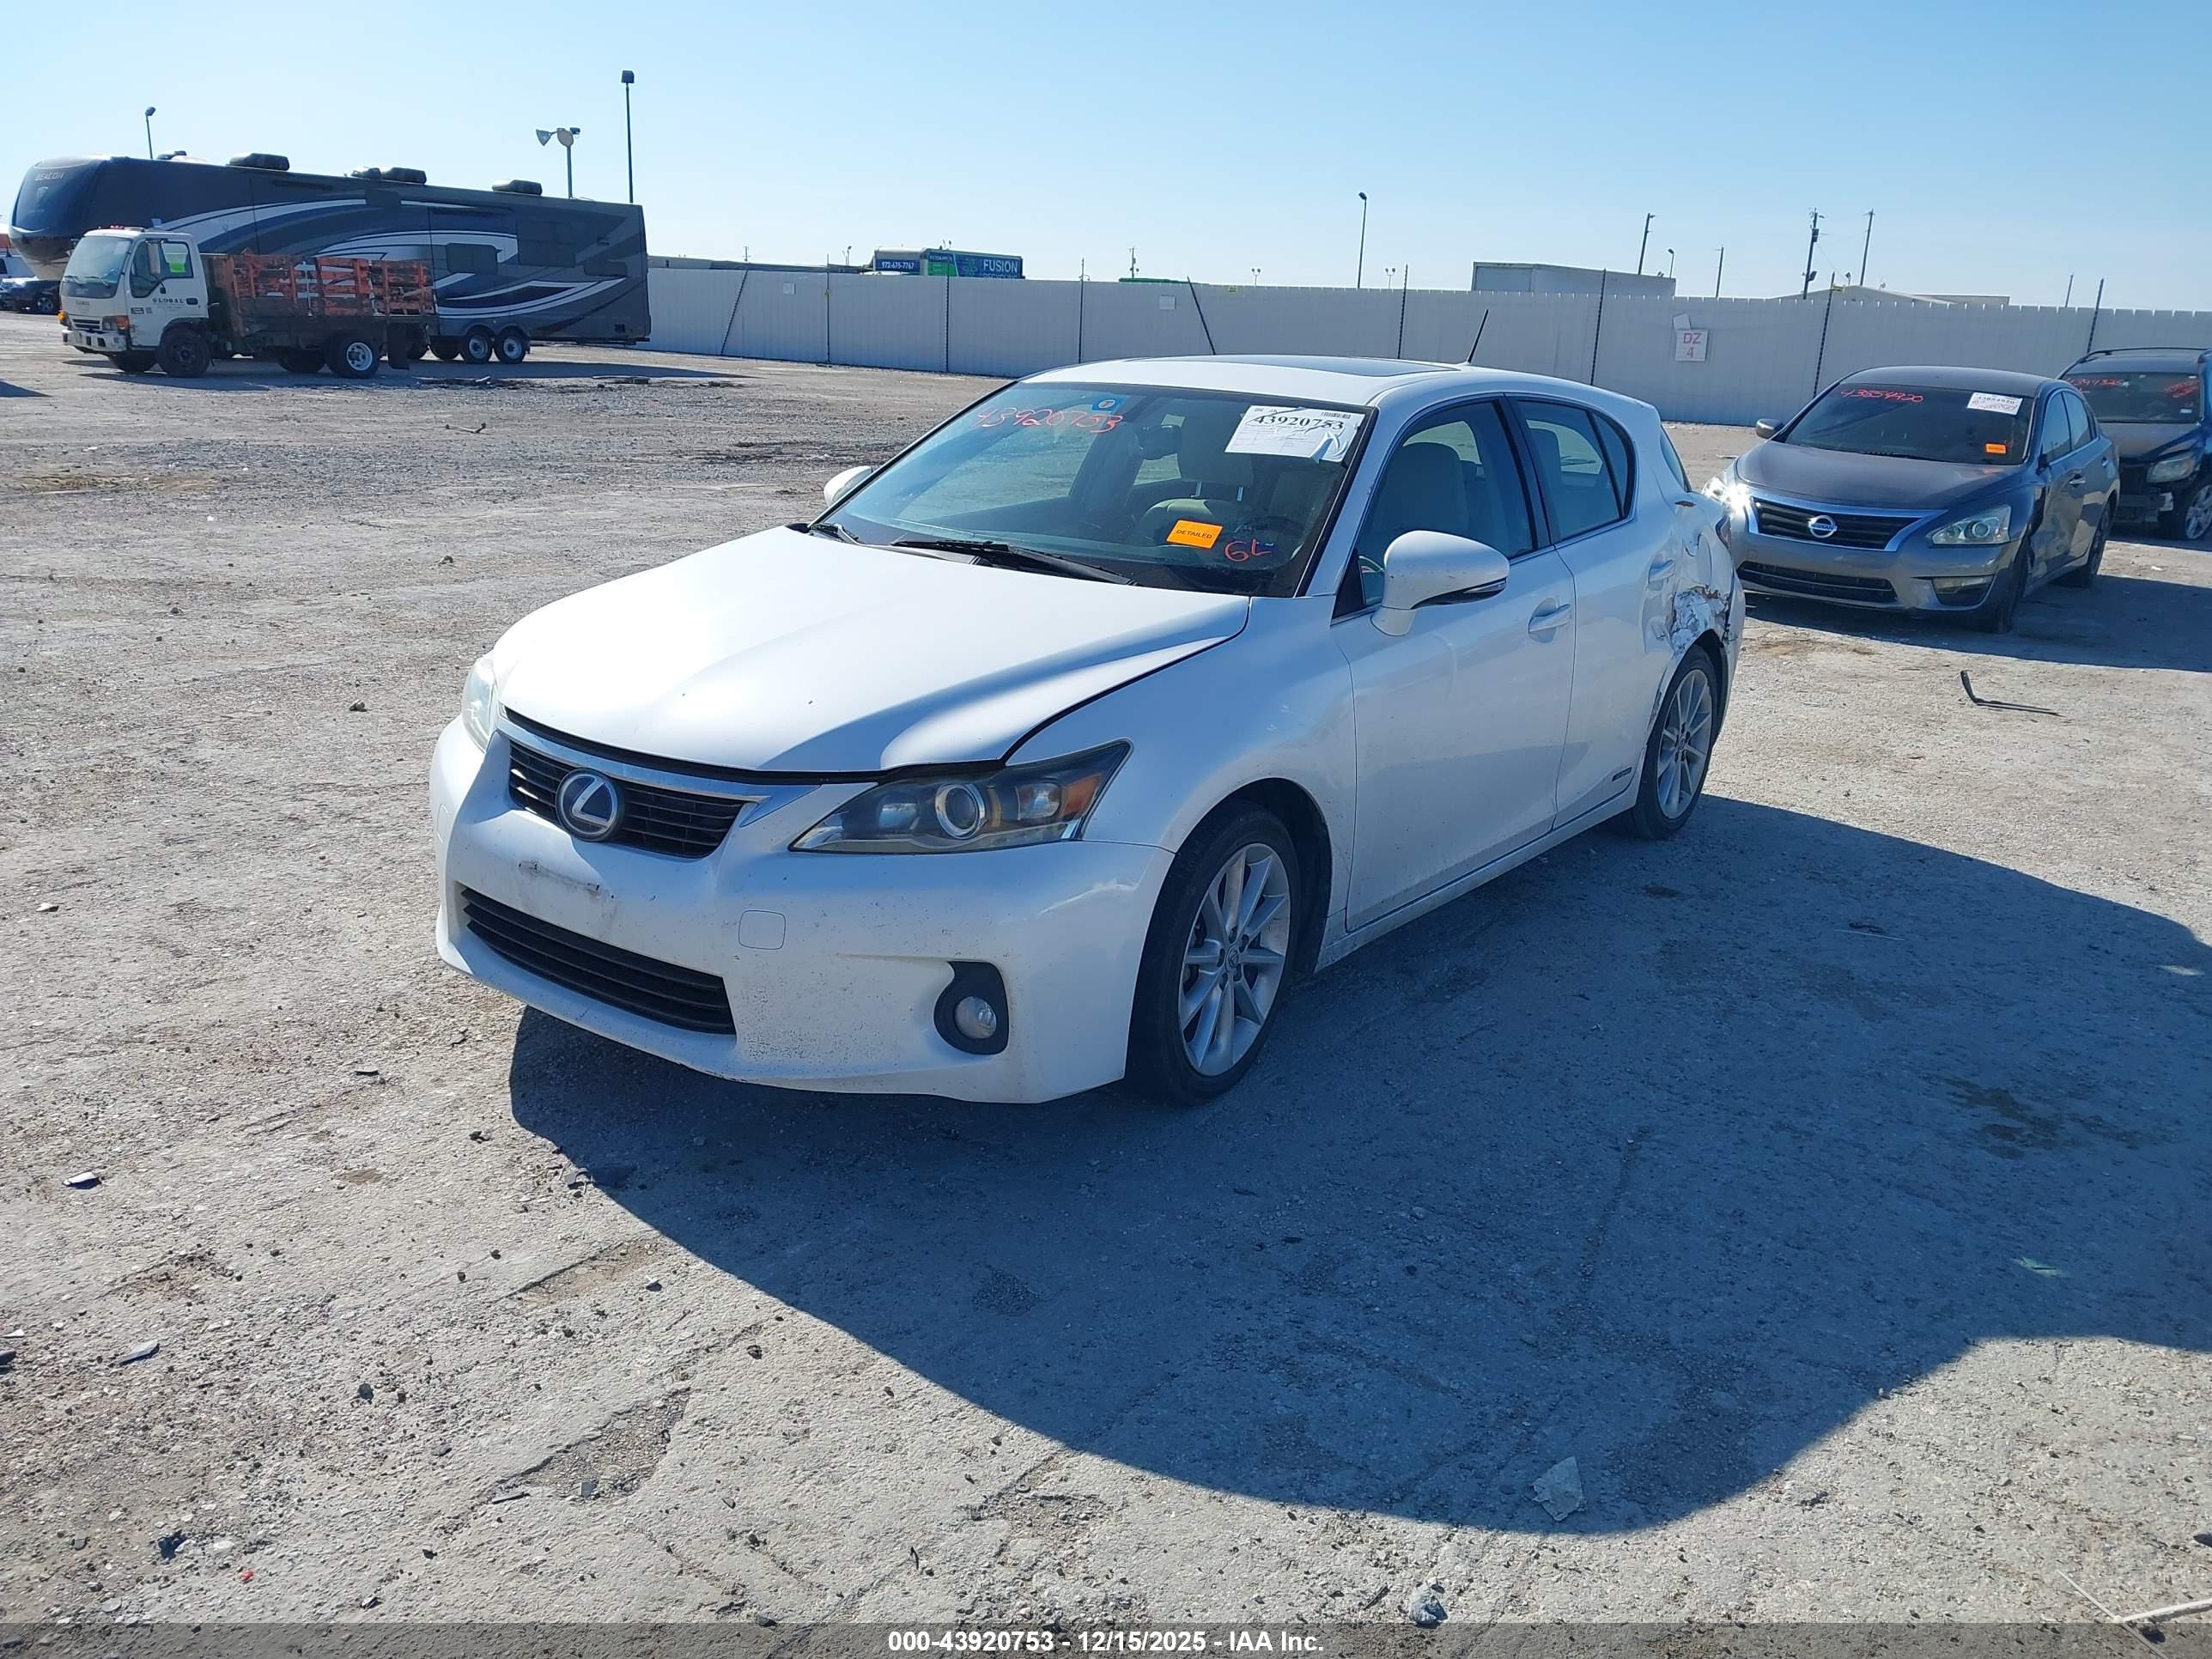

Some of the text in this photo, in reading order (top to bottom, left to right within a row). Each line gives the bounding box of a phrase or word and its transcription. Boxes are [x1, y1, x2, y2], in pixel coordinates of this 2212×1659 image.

[983, 259, 1018, 273] FUSION
[1683, 332, 1702, 344] DZ
[1686, 346, 1694, 358] 4
[975, 407, 1123, 433] 43920753
[1254, 415, 1345, 430] 43920753
[1176, 529, 1213, 539] DETAILED
